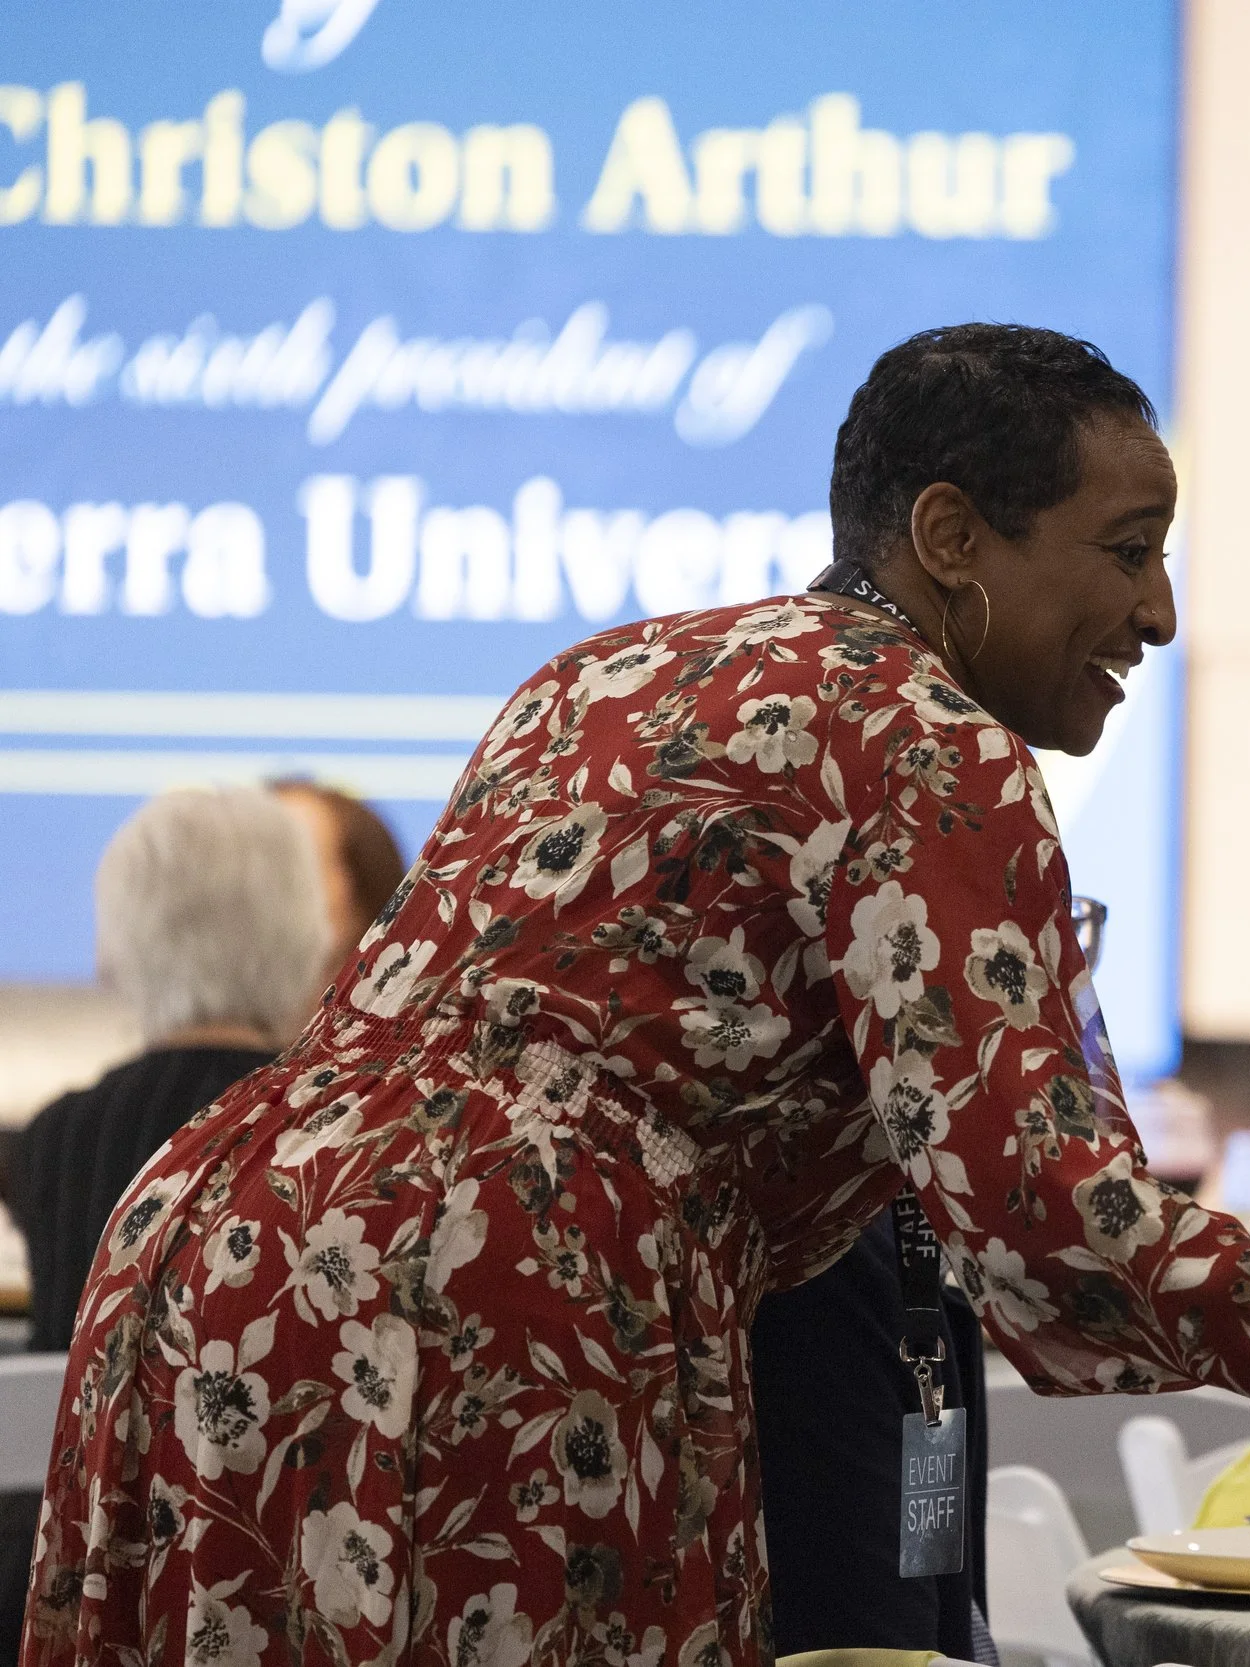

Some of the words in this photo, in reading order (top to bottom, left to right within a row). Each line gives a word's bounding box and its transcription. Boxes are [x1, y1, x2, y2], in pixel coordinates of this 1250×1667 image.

[583, 92, 1074, 238] Arthur
[909, 1453, 957, 1486] EVENT
[907, 1495, 956, 1532] STAFF
